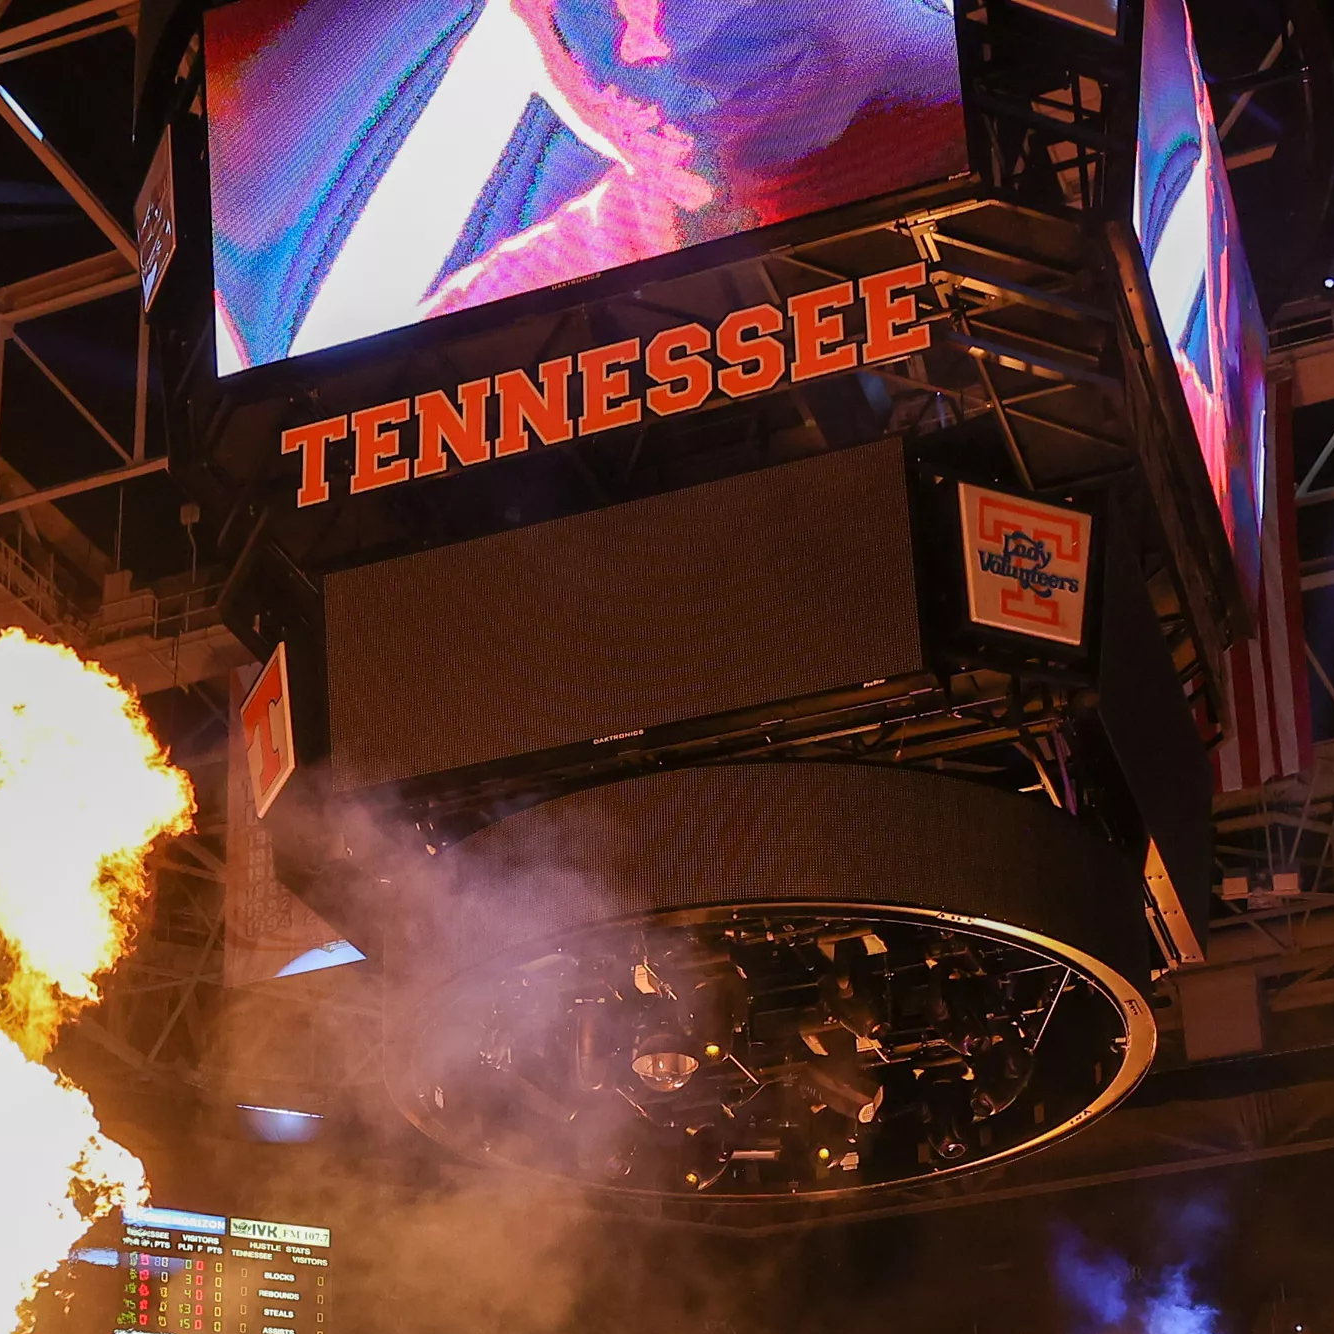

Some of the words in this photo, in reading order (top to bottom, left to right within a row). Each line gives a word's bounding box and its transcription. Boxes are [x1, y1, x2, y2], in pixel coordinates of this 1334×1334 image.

[281, 261, 932, 508] TENNESSEE
[1003, 531, 1052, 567] Lady
[978, 550, 1080, 598] Volunteers
[593, 729, 645, 745] DAKTRONICS
[182, 1234, 220, 1245] VISITORS
[283, 1229, 300, 1240] FM
[304, 1231, 328, 1243] 107.7
[154, 1240, 171, 1249] PTS
[178, 1243, 194, 1251] PLR
[207, 1246, 223, 1255] PTS
[249, 1242, 282, 1252] HUSTLE
[286, 1246, 311, 1255] STATS
[231, 1249, 273, 1260] TENNESSEE
[292, 1256, 328, 1267] VISITORS
[185, 1274, 192, 1285] 3
[264, 1271, 295, 1282] BLOCKS
[184, 1289, 192, 1299] 4
[258, 1289, 300, 1300] REBOUNDS
[263, 1308, 294, 1318] STEALS
